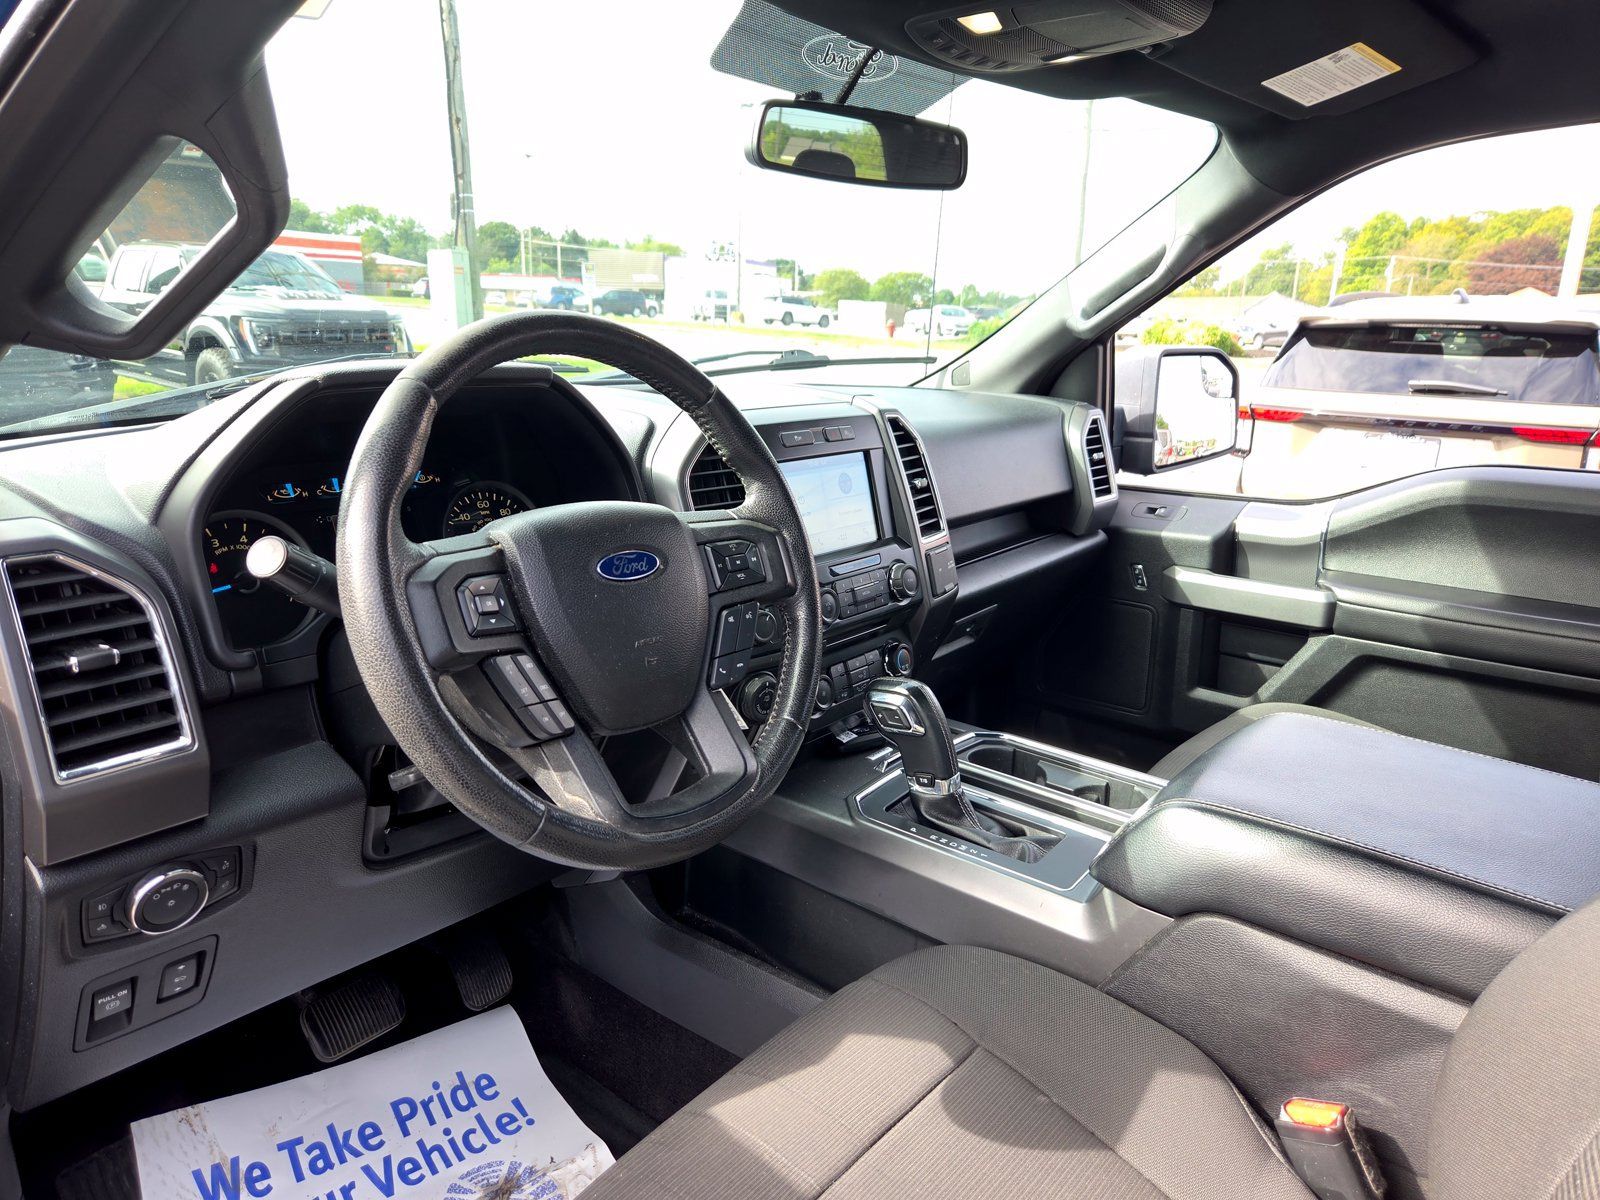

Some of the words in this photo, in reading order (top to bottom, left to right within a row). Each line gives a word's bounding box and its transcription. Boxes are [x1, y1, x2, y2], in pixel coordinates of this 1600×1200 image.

[476, 500, 490, 509] 60
[459, 513, 471, 521] 40
[499, 508, 511, 516] 80
[210, 538, 220, 548] 3
[239, 535, 248, 543] 4
[214, 546, 229, 556] RPM
[612, 554, 649, 575] Ford
[98, 994, 116, 1005] PULL
[117, 988, 128, 997] ON
[191, 1155, 274, 1200] We
[276, 1121, 387, 1183] Take
[389, 1071, 501, 1138] Pride
[360, 1097, 536, 1198] Vehicle!
